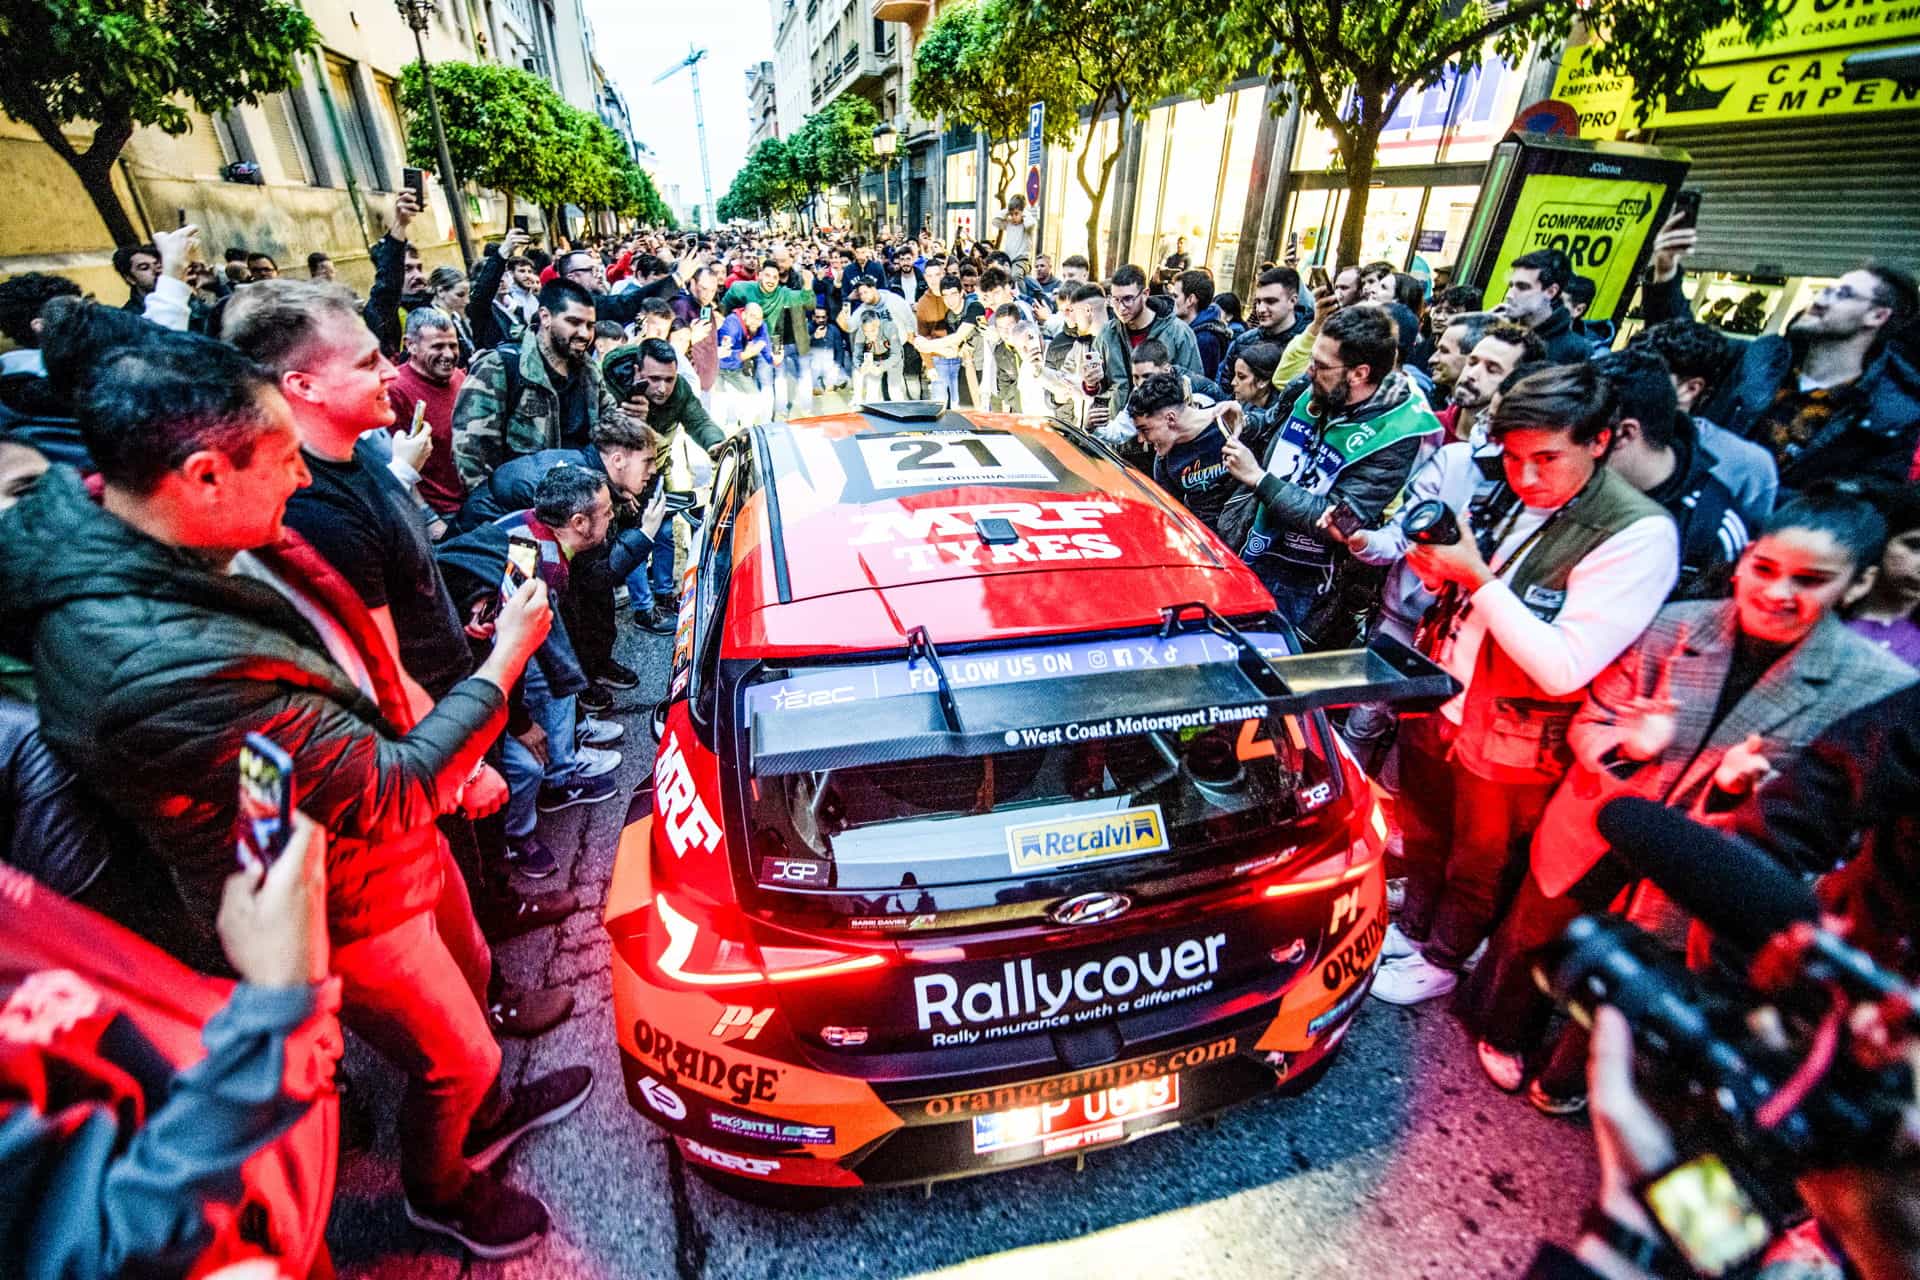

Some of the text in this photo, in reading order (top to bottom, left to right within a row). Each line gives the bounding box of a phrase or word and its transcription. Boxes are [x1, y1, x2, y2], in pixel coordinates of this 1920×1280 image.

[1800, 18, 1847, 36] CASA
[1854, 14, 1878, 28] DE
[1534, 232, 1552, 246] TU
[1537, 213, 1626, 231] COMPRAMOS
[890, 439, 1003, 471] 21
[849, 501, 1122, 546] MRF
[895, 533, 1123, 573] TYRES
[1007, 655, 1037, 679] US
[1043, 652, 1073, 673] ON
[1020, 704, 1269, 746] West Coast Motorsport Finance
[655, 730, 724, 860] MRF
[1044, 821, 1131, 857] Recalvi
[913, 932, 1226, 1030] Rallycover
[710, 1004, 776, 1040] P1
[932, 979, 1213, 1048] Rally insurance with a difference
[633, 1018, 779, 1106] ORANGE
[924, 1036, 1238, 1117] orangeamps.com
[686, 1137, 781, 1176] MRF
